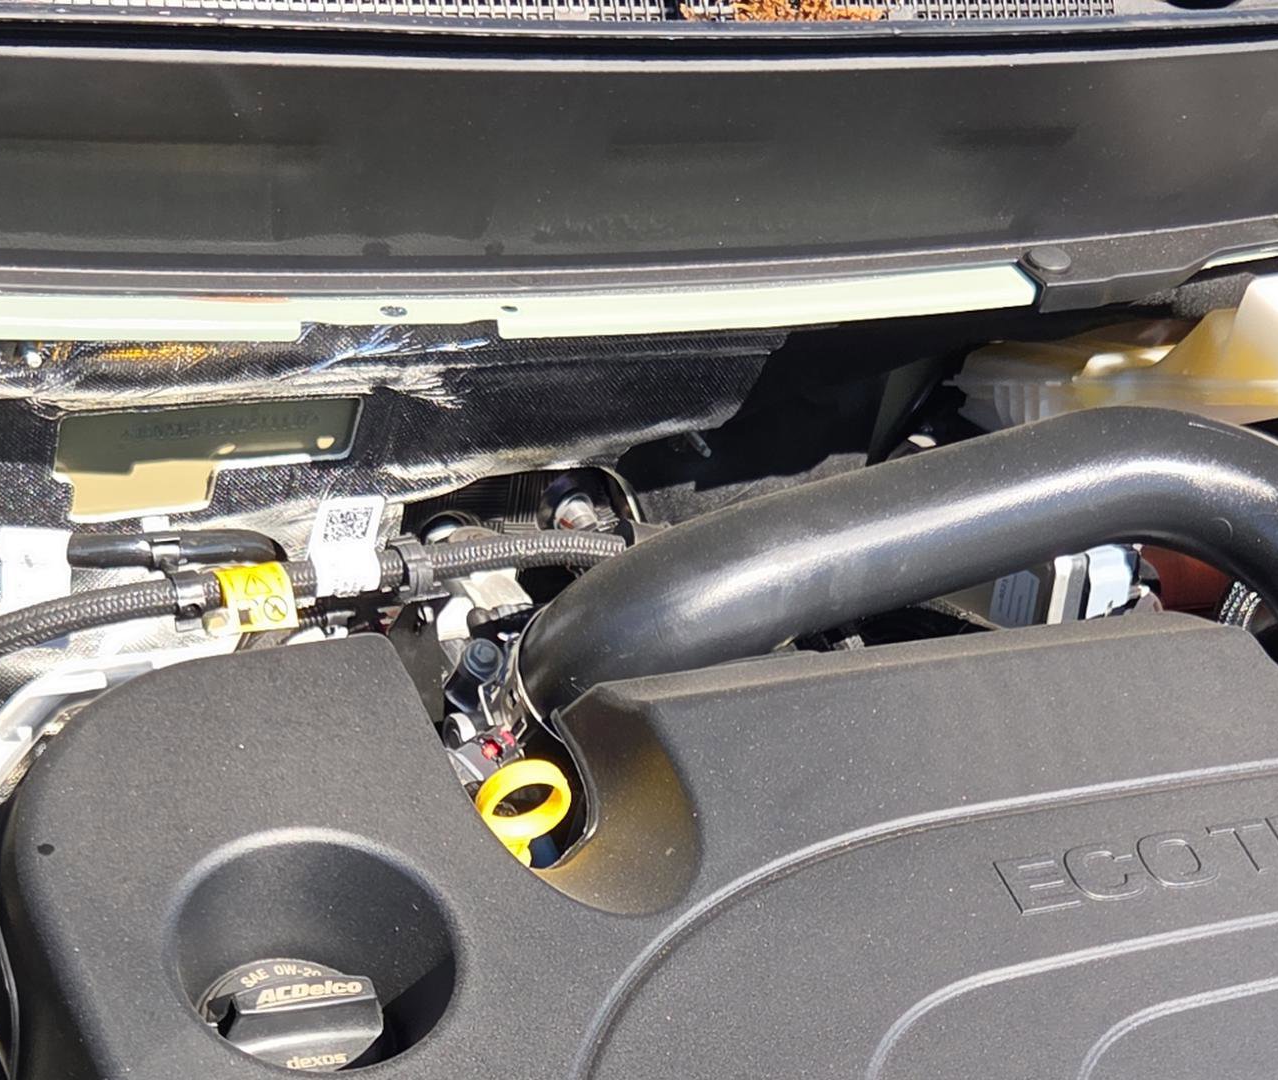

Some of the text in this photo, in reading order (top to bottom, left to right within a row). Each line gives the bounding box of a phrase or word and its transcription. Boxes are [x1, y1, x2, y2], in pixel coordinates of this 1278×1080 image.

[240, 968, 270, 988] SAE
[257, 980, 363, 1007] ACDelco
[286, 1053, 348, 1070] dexos
